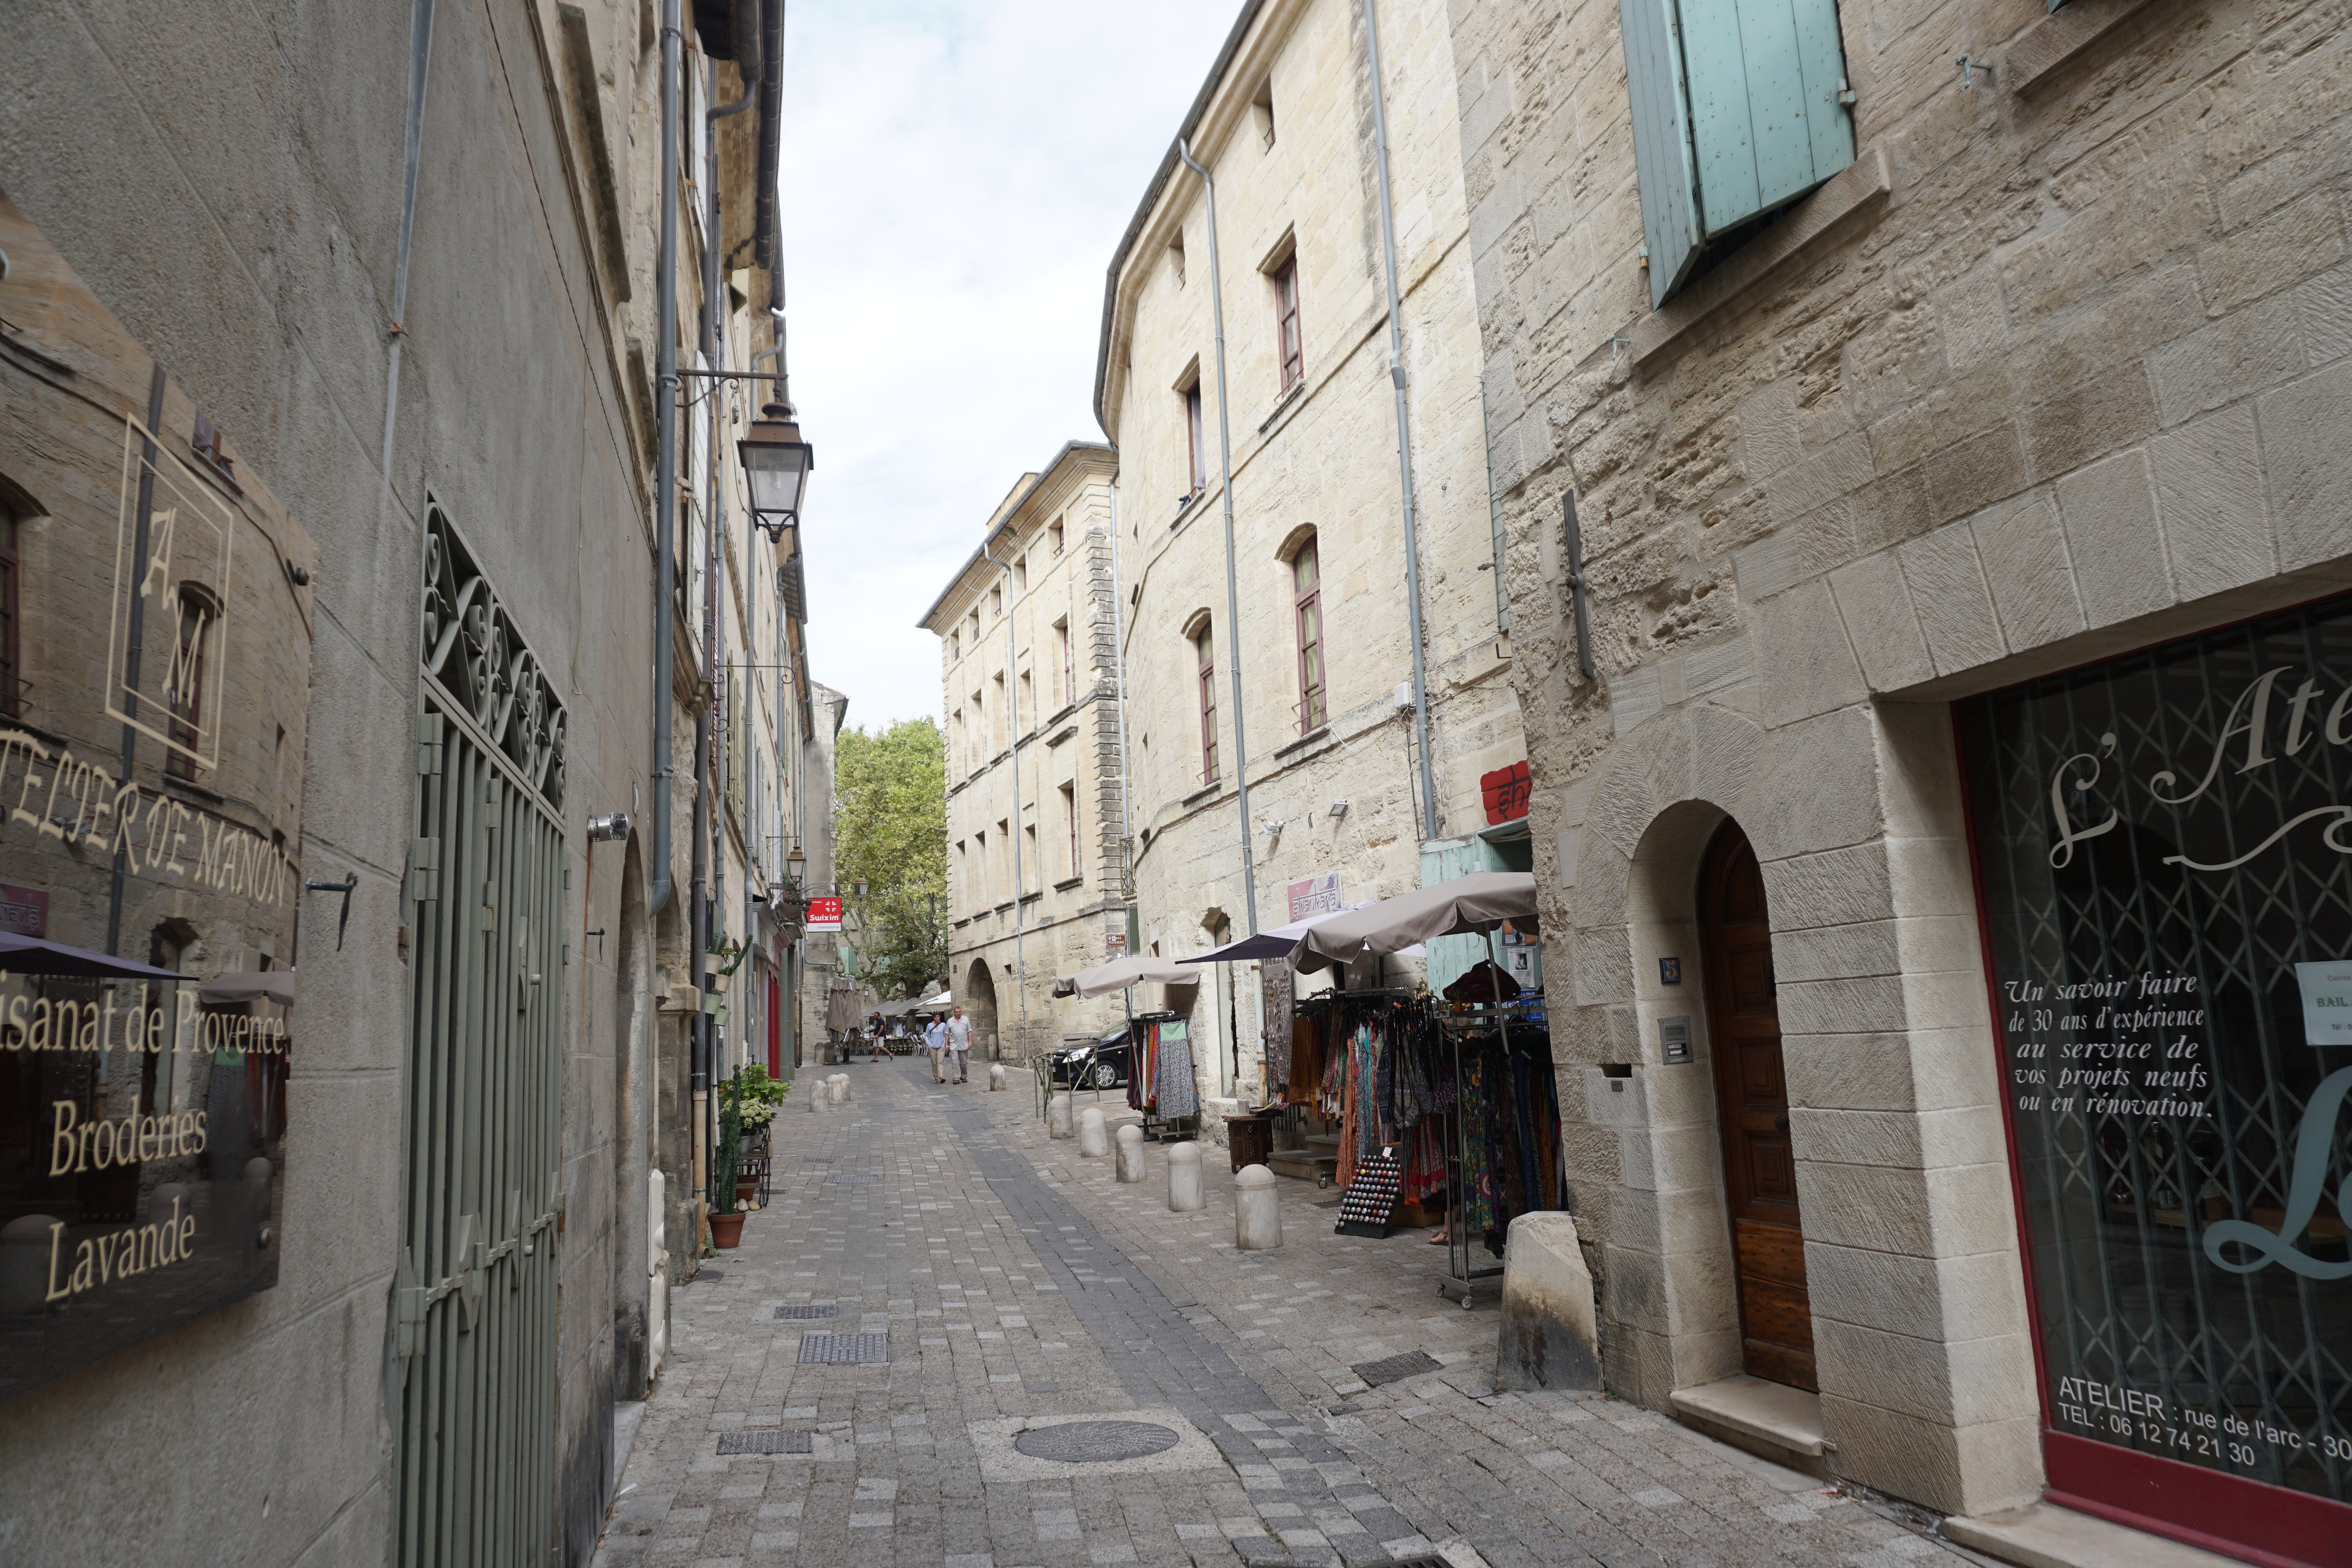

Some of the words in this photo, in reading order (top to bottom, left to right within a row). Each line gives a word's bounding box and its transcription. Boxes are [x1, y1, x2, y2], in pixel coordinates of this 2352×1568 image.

[145, 795, 191, 875] DE
[194, 811, 289, 908] MANON
[1666, 960, 1678, 979] 5
[2004, 979, 2043, 1002] Un
[2055, 974, 2127, 1000] savoir
[2137, 970, 2198, 999] faire
[2316, 997, 2348, 1007] BAIL
[125, 982, 165, 1054] de
[171, 989, 285, 1055] Provence
[2009, 1011, 2024, 1032] de
[2032, 1009, 2053, 1031] 30
[2060, 1014, 2087, 1030] ans
[2017, 1043, 2046, 1058] au
[2060, 1035, 2152, 1058] service
[2167, 1035, 2199, 1058] de
[2014, 1069, 2046, 1084] vos
[2057, 1062, 2130, 1089] projets
[2144, 1063, 2208, 1091] neufs
[2019, 1095, 2041, 1111] ou
[2052, 1096, 2074, 1112] en
[2086, 1092, 2212, 1118] rénovation.
[49, 1094, 207, 1177] Broderies
[45, 1194, 196, 1302] Lavande
[2059, 1375, 2167, 1421] ATELIER
[2184, 1408, 2217, 1429] rue
[2223, 1414, 2250, 1436] de
[2255, 1419, 2301, 1448] l'arc
[2058, 1402, 2095, 1427] TEL
[2110, 1414, 2132, 1436] 06
[2139, 1421, 2161, 1443] 12
[2166, 1427, 2191, 1450] 74
[2196, 1434, 2220, 1458] 21
[2229, 1442, 2255, 1466] 30
